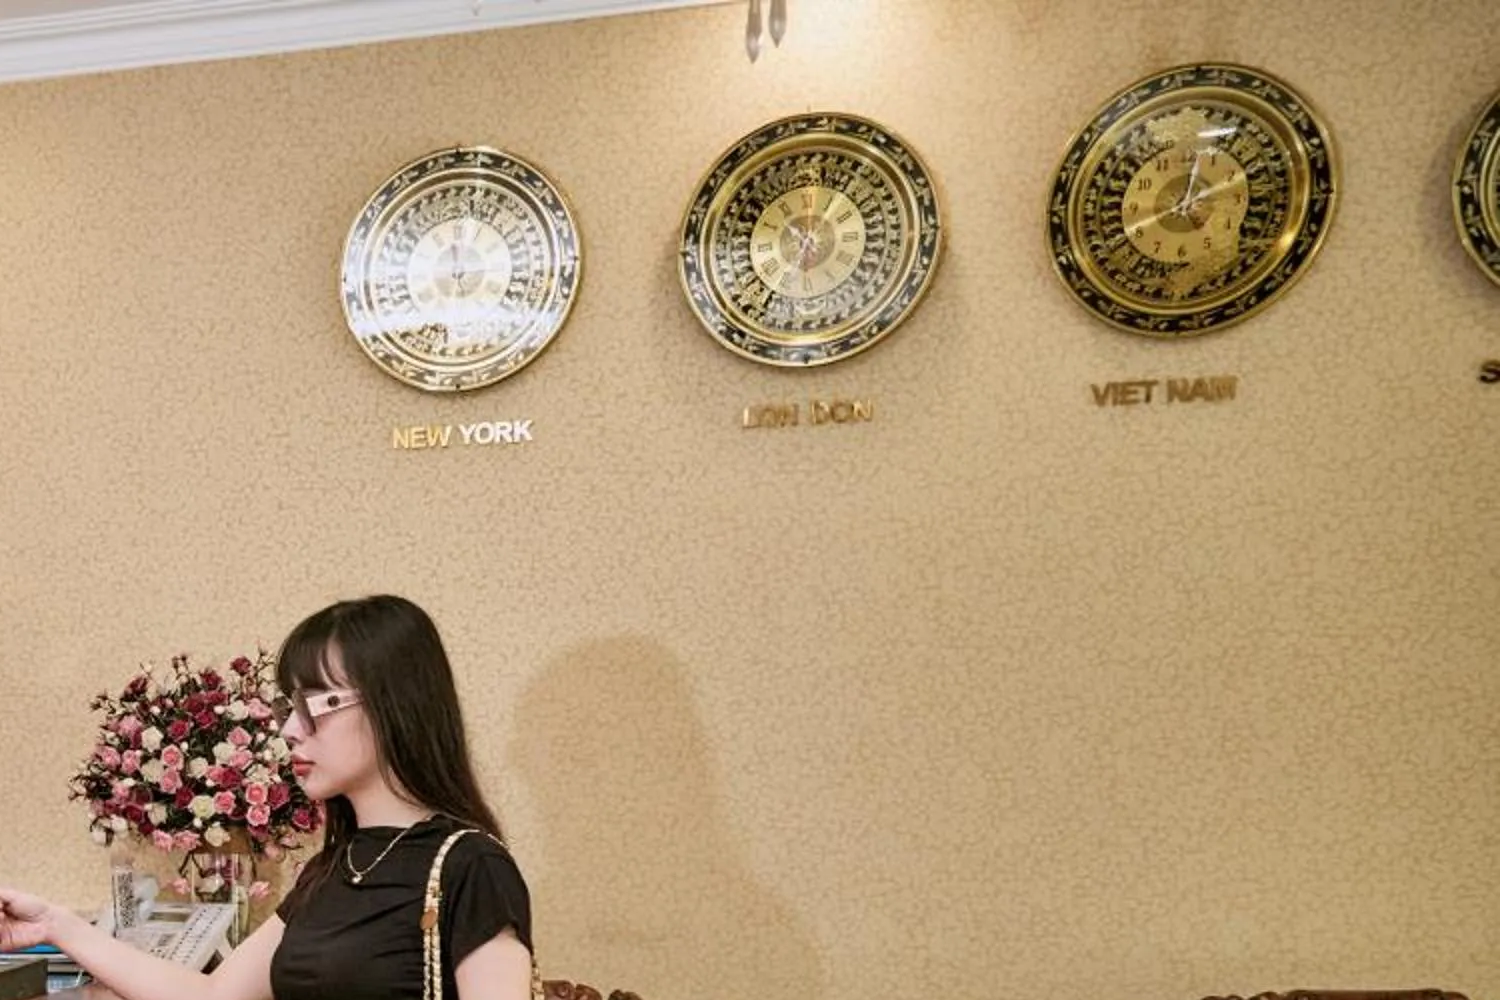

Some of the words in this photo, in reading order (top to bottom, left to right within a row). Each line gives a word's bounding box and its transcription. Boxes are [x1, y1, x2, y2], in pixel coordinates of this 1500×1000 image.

[1091, 379, 1159, 407] VIET
[1167, 375, 1238, 403] NAM
[812, 400, 872, 424] DON
[393, 426, 452, 449] NEW
[459, 420, 533, 444] YORK
